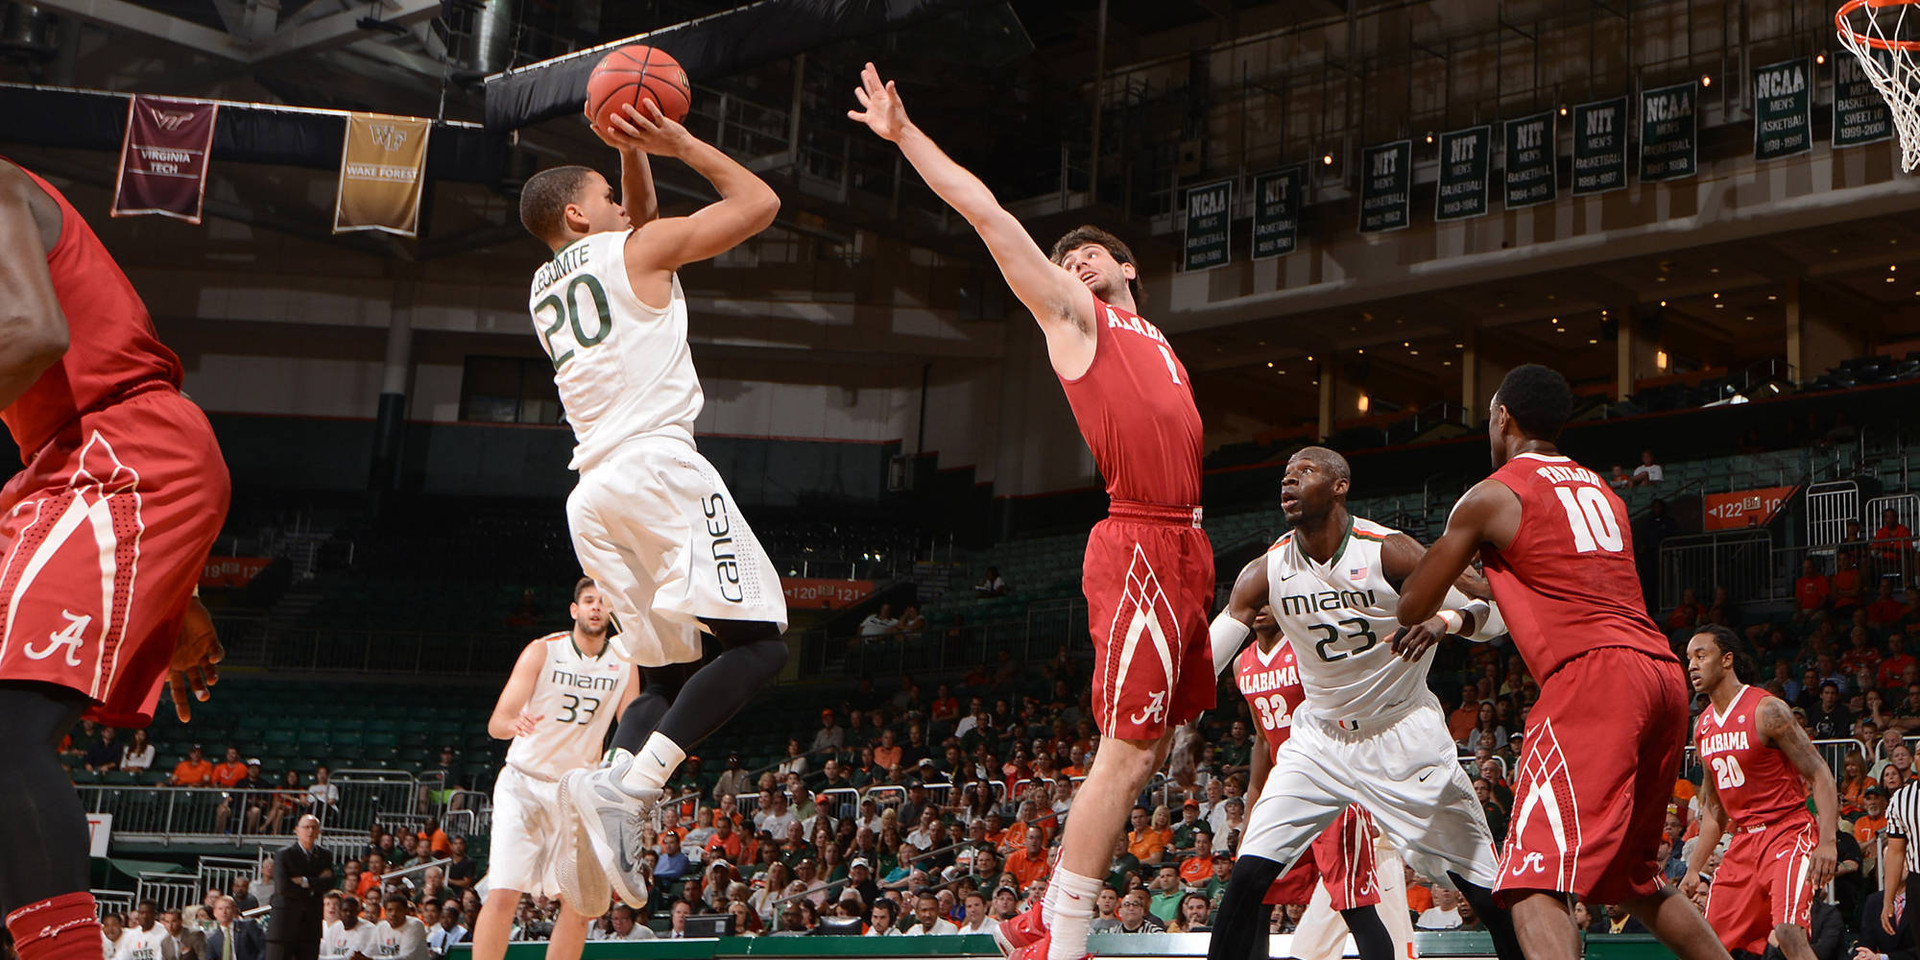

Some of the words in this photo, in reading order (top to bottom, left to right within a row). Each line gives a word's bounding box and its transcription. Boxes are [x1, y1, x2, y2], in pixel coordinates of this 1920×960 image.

[1758, 65, 1805, 99] NCAA
[1646, 91, 1692, 123] NCAA
[1770, 96, 1795, 112] MEN'S
[1844, 110, 1871, 126] SWEET
[1516, 121, 1544, 150] NIT
[1586, 107, 1615, 136] NIT
[1841, 121, 1885, 139] 1999-2000
[141, 150, 191, 163] VIRGINIA
[1450, 135, 1478, 163] NIT
[1588, 135, 1613, 150] MEN'S
[150, 162, 178, 174] TECH
[346, 165, 377, 176] WAKE
[379, 167, 418, 180] FOREST
[1372, 148, 1398, 177] NIT
[1575, 153, 1622, 170] BASKETBALL
[1190, 189, 1226, 218] NCAA
[1265, 177, 1289, 204] NIT
[534, 243, 589, 296] LECOMTE
[534, 273, 612, 370] 20
[1105, 307, 1173, 350] ALAB
[1157, 344, 1182, 385] 1
[1536, 465, 1602, 488] TAYLOR
[1554, 486, 1624, 553] 10
[1718, 502, 1743, 519] 122
[204, 564, 220, 578] 19
[794, 587, 817, 600] 120
[838, 588, 859, 601] 121
[1307, 617, 1377, 663] 23
[1239, 665, 1300, 695] ALABAMA
[556, 693, 601, 725] 33
[1254, 694, 1292, 731] 32
[1701, 731, 1750, 758] ALABAMA
[1711, 755, 1746, 790] 20
